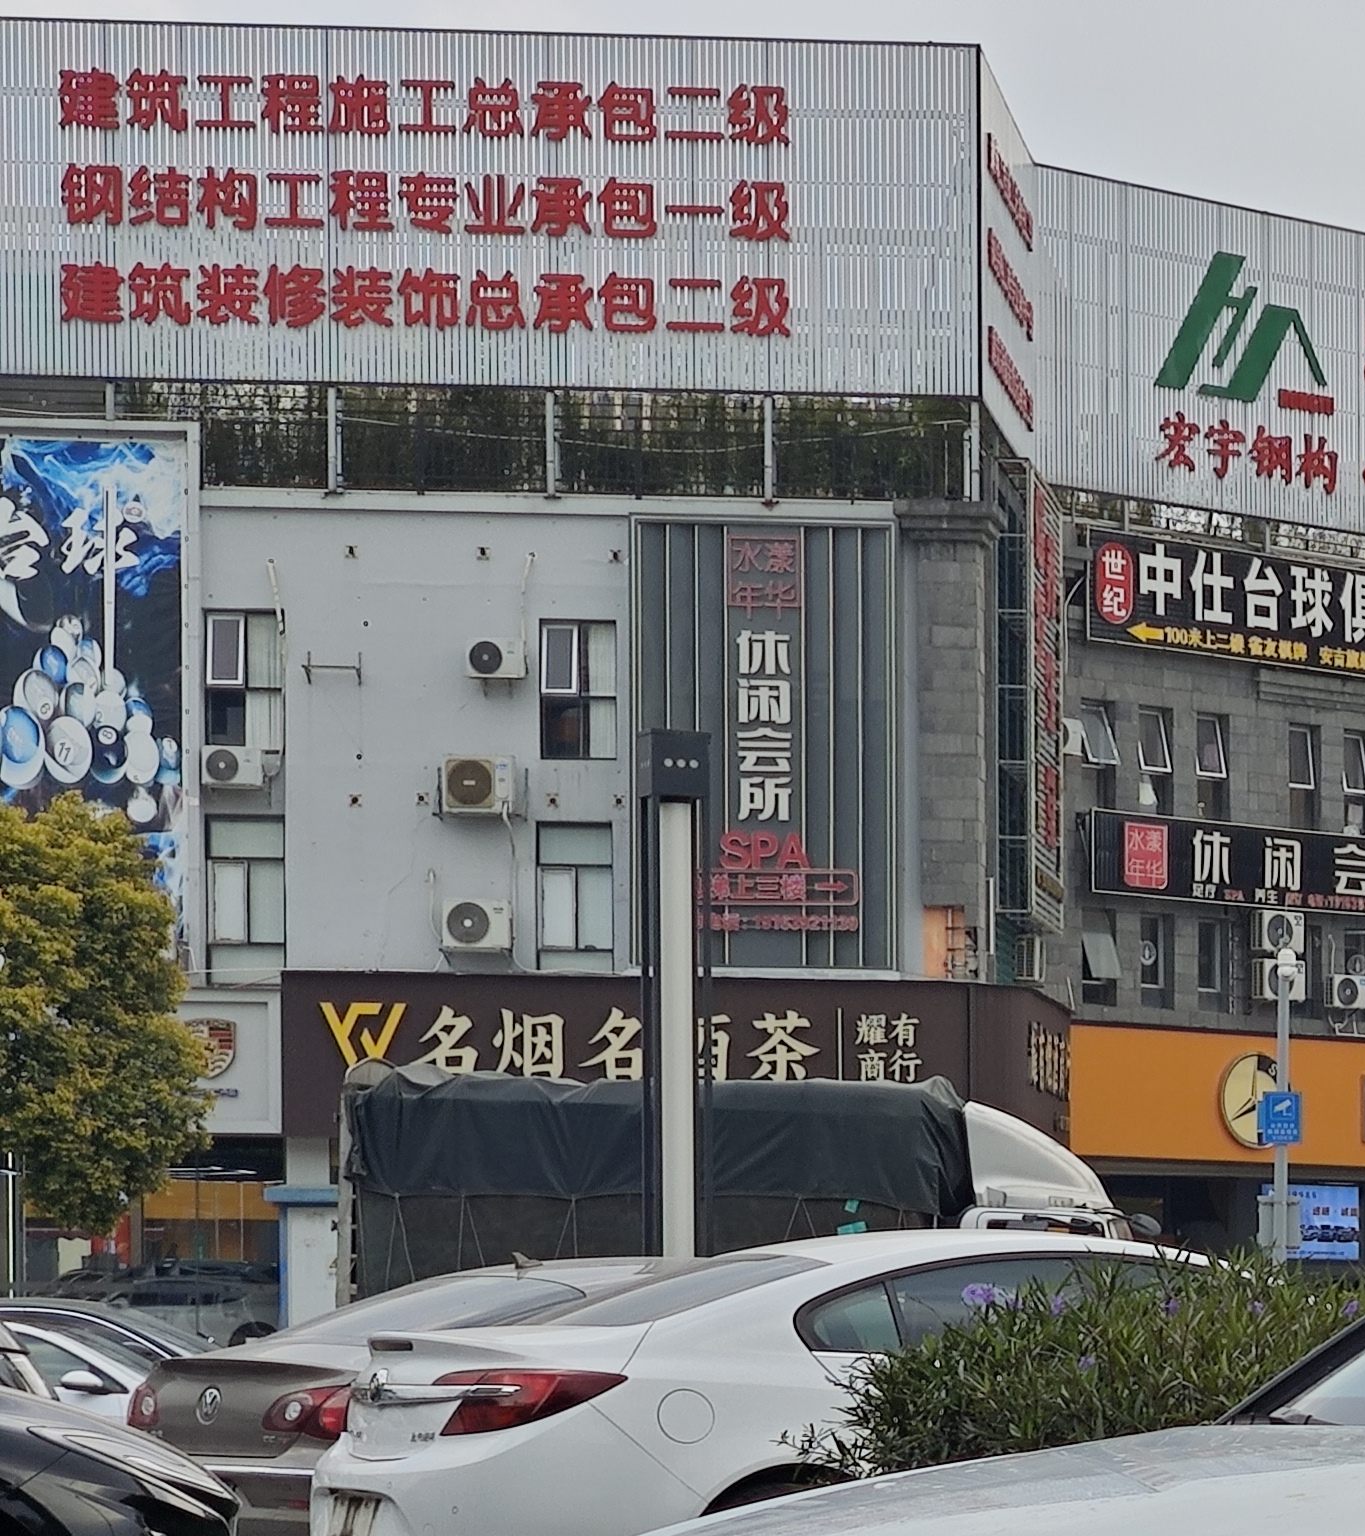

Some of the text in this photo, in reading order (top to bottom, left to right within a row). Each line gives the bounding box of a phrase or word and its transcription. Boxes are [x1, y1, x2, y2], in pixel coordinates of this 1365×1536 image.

[59, 68, 791, 147] 建筑工程施工总承包二级
[61, 164, 791, 243] 钢结构工程专业承包一级
[60, 263, 792, 338] 建筑装修装饰总承包二级
[1156, 411, 1339, 495] 宏宇钢构
[1101, 548, 1128, 618] 世纪
[58, 741, 72, 763] 11
[735, 629, 794, 822] 休闲会所
[719, 830, 811, 870] SPA
